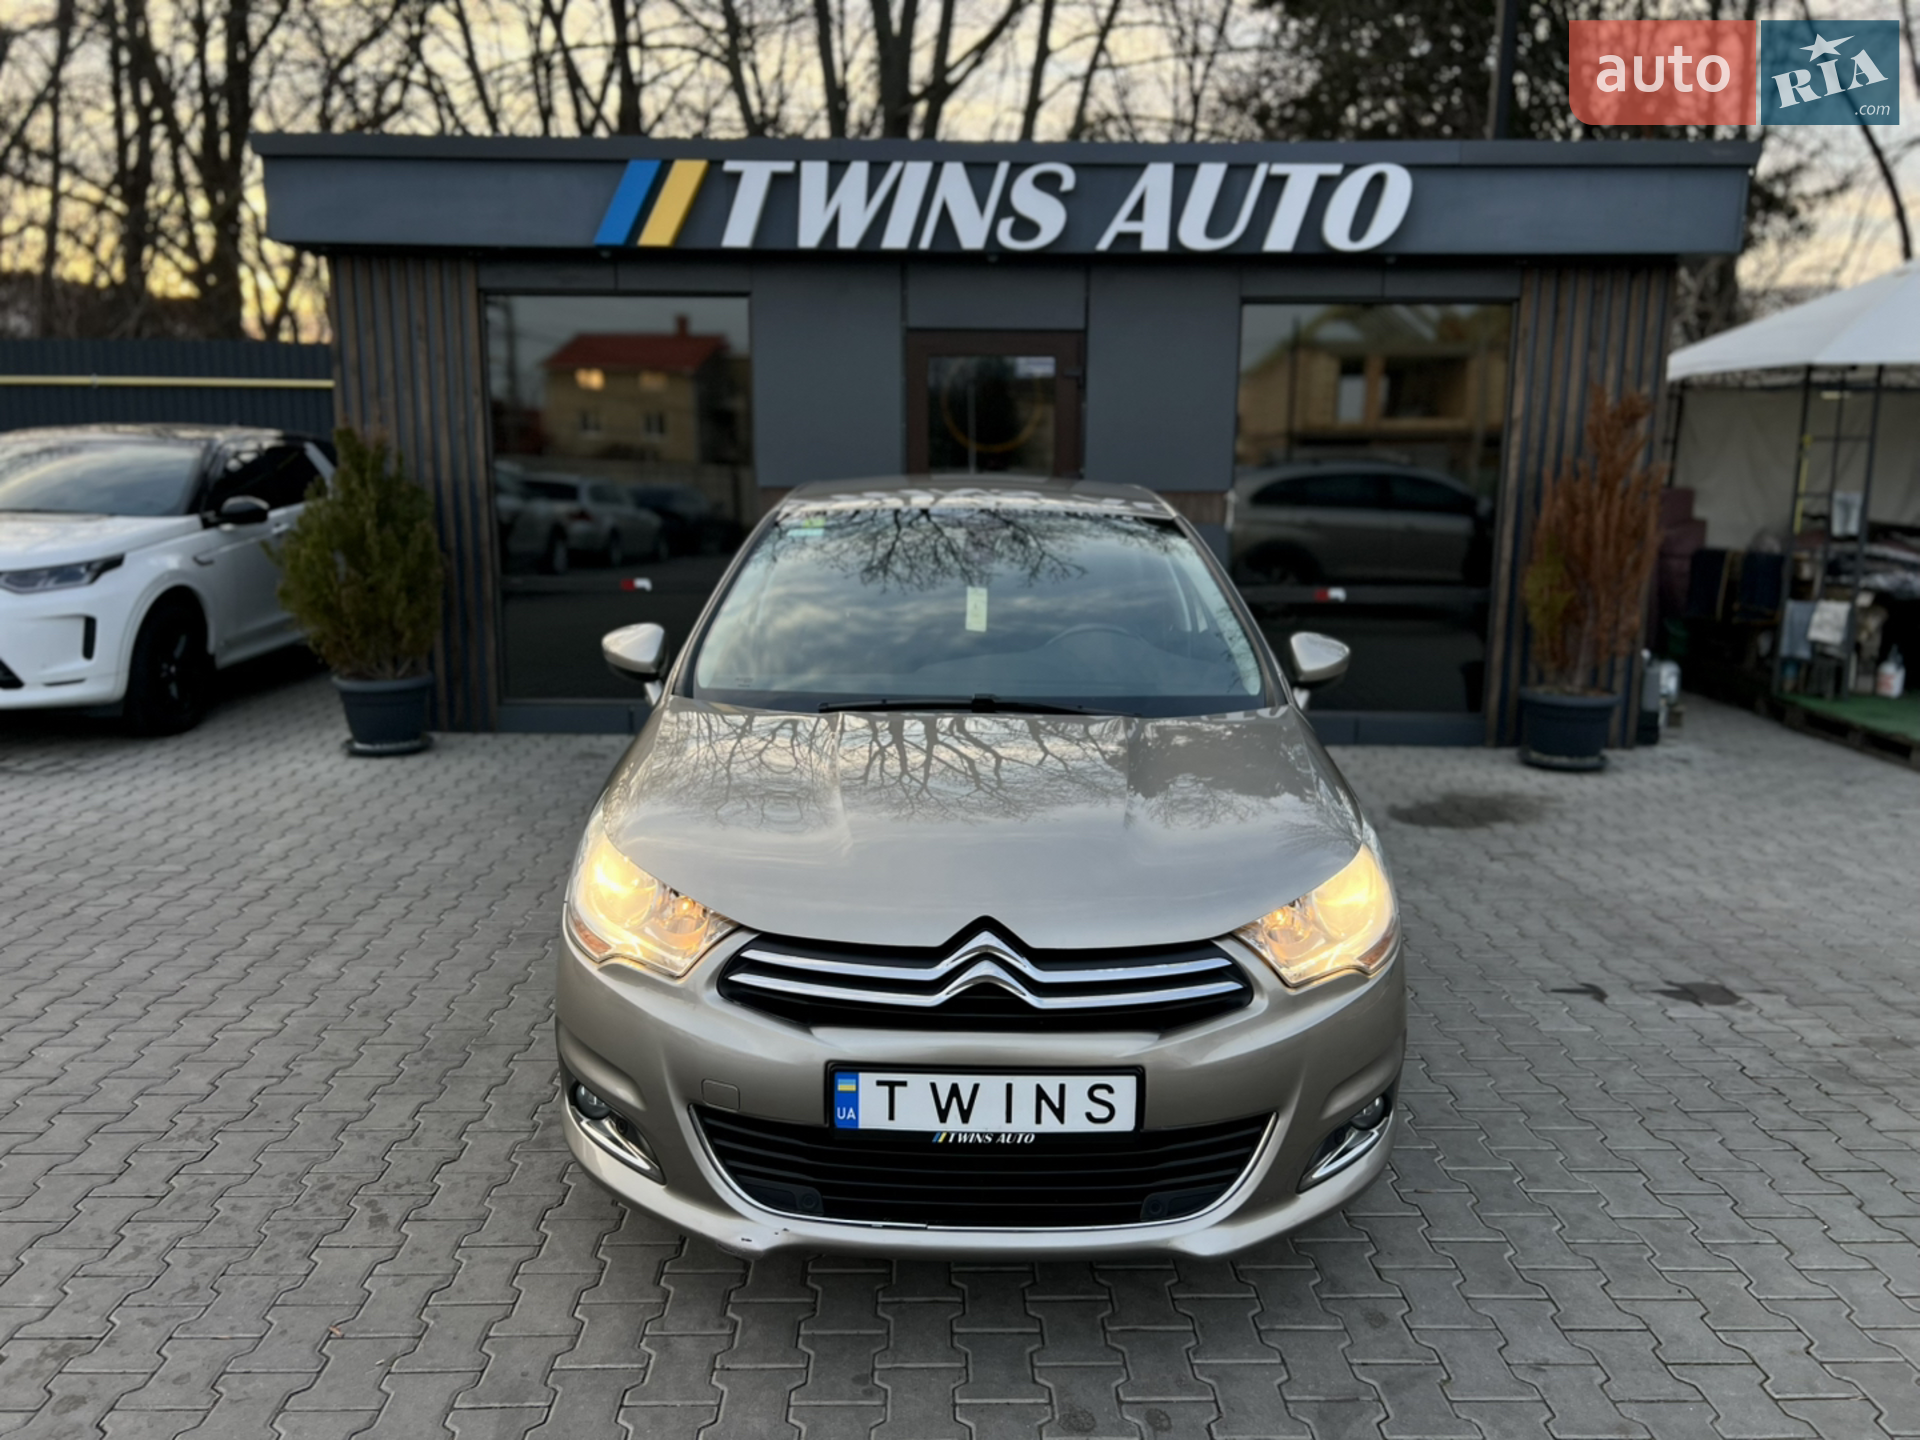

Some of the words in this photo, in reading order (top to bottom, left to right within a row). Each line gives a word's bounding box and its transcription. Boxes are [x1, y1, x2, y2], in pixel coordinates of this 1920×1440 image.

[720, 159, 1076, 251] TWINS
[1096, 161, 1414, 253] AUTO
[836, 1107, 857, 1120] UA
[876, 1079, 1116, 1125] TWINS
[948, 1132, 993, 1144] TWINS
[995, 1132, 1036, 1144] AUTO
